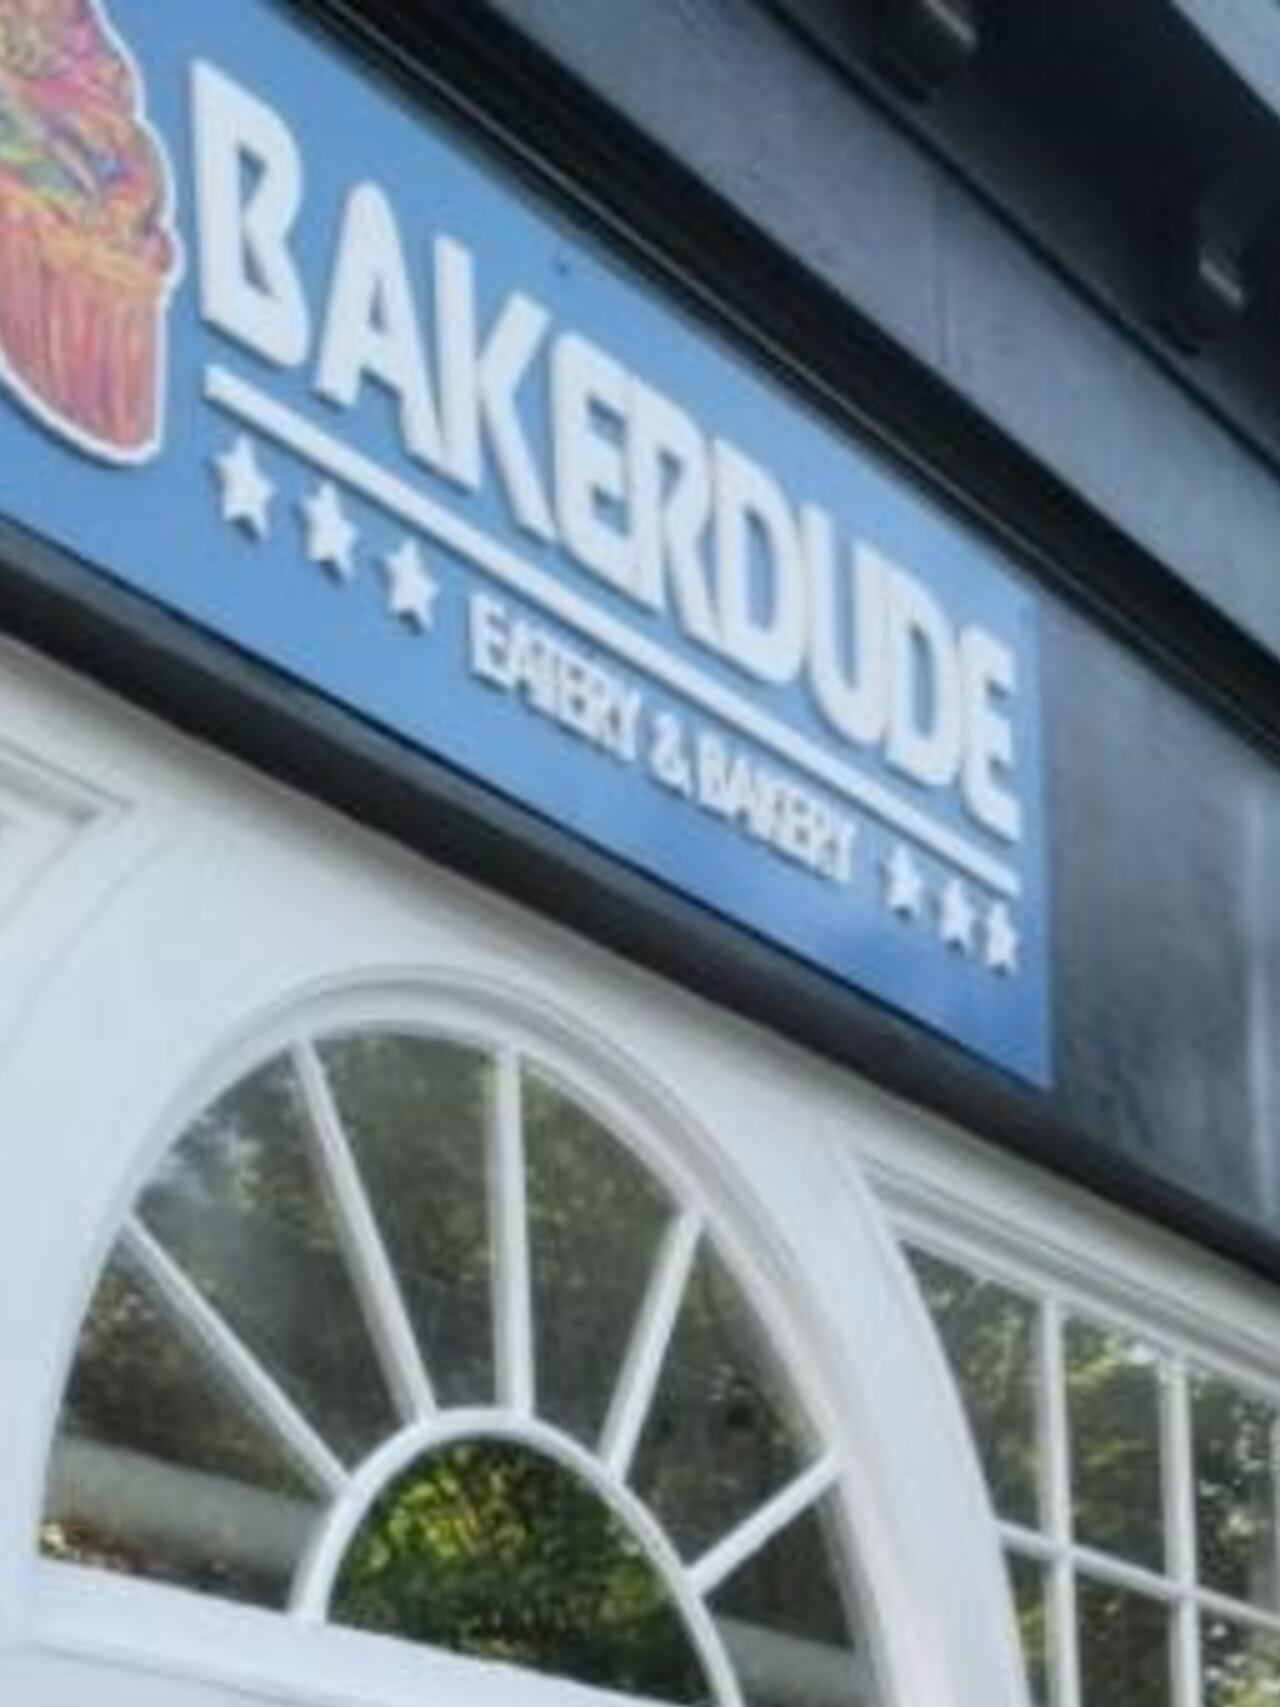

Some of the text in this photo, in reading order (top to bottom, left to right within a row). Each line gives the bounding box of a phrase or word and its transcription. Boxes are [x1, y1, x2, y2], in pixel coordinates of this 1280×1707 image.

[190, 60, 1022, 844] BAKERDUDE
[470, 592, 858, 883] EATERY & BAKERY
